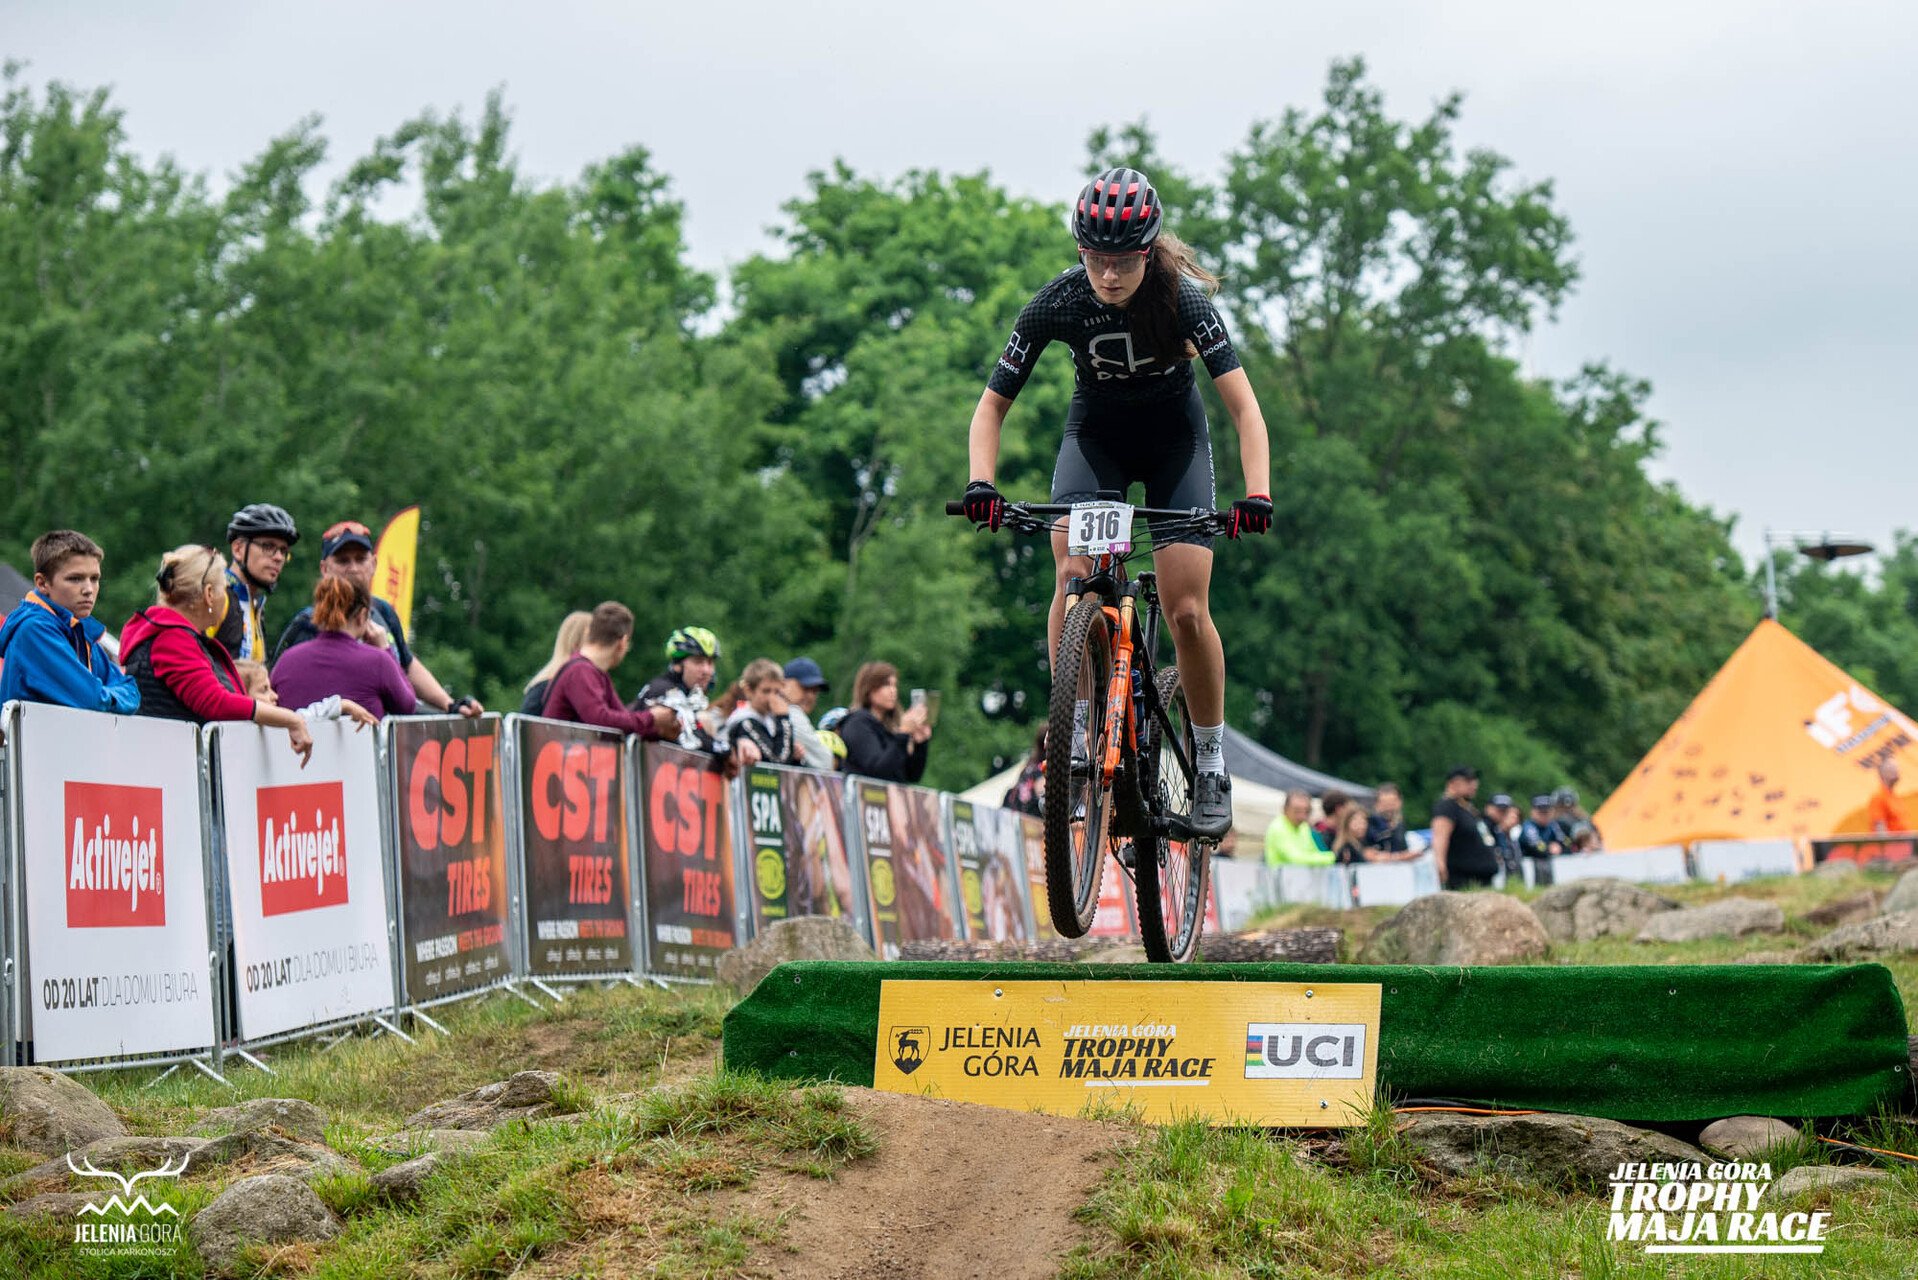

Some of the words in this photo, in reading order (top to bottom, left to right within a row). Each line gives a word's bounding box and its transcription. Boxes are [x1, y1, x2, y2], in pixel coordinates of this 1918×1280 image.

[1203, 338, 1227, 357] DOORS
[1081, 511, 1121, 542] 316
[409, 735, 494, 850] CST
[532, 740, 617, 843] CST
[651, 762, 722, 861] CST
[751, 792, 782, 833] SPA
[864, 805, 892, 845] SPA
[70, 814, 158, 912] Activejet
[263, 808, 340, 896] Activejet
[447, 856, 491, 917] TIRES
[569, 855, 613, 904] TIRES
[683, 868, 721, 917] TIRES
[43, 978, 60, 1010] OD
[62, 978, 75, 1009] 20
[79, 977, 99, 1008] LAT
[102, 976, 123, 1006] DLA
[124, 974, 156, 1005] DOMU
[164, 972, 199, 1003] BIURA
[246, 964, 260, 993] OD
[260, 961, 272, 989] 20
[274, 957, 292, 986] LAT
[939, 1027, 1041, 1051] JELENIA
[1063, 1025, 1129, 1038] JELENIA
[1131, 1021, 1177, 1038] GÓRA
[1063, 1038, 1175, 1058] TROPHY
[963, 1050, 1040, 1077] GÓRA
[1059, 1058, 1137, 1079] MAJA
[1142, 1057, 1216, 1078] RACE
[1266, 1034, 1354, 1067] UCI
